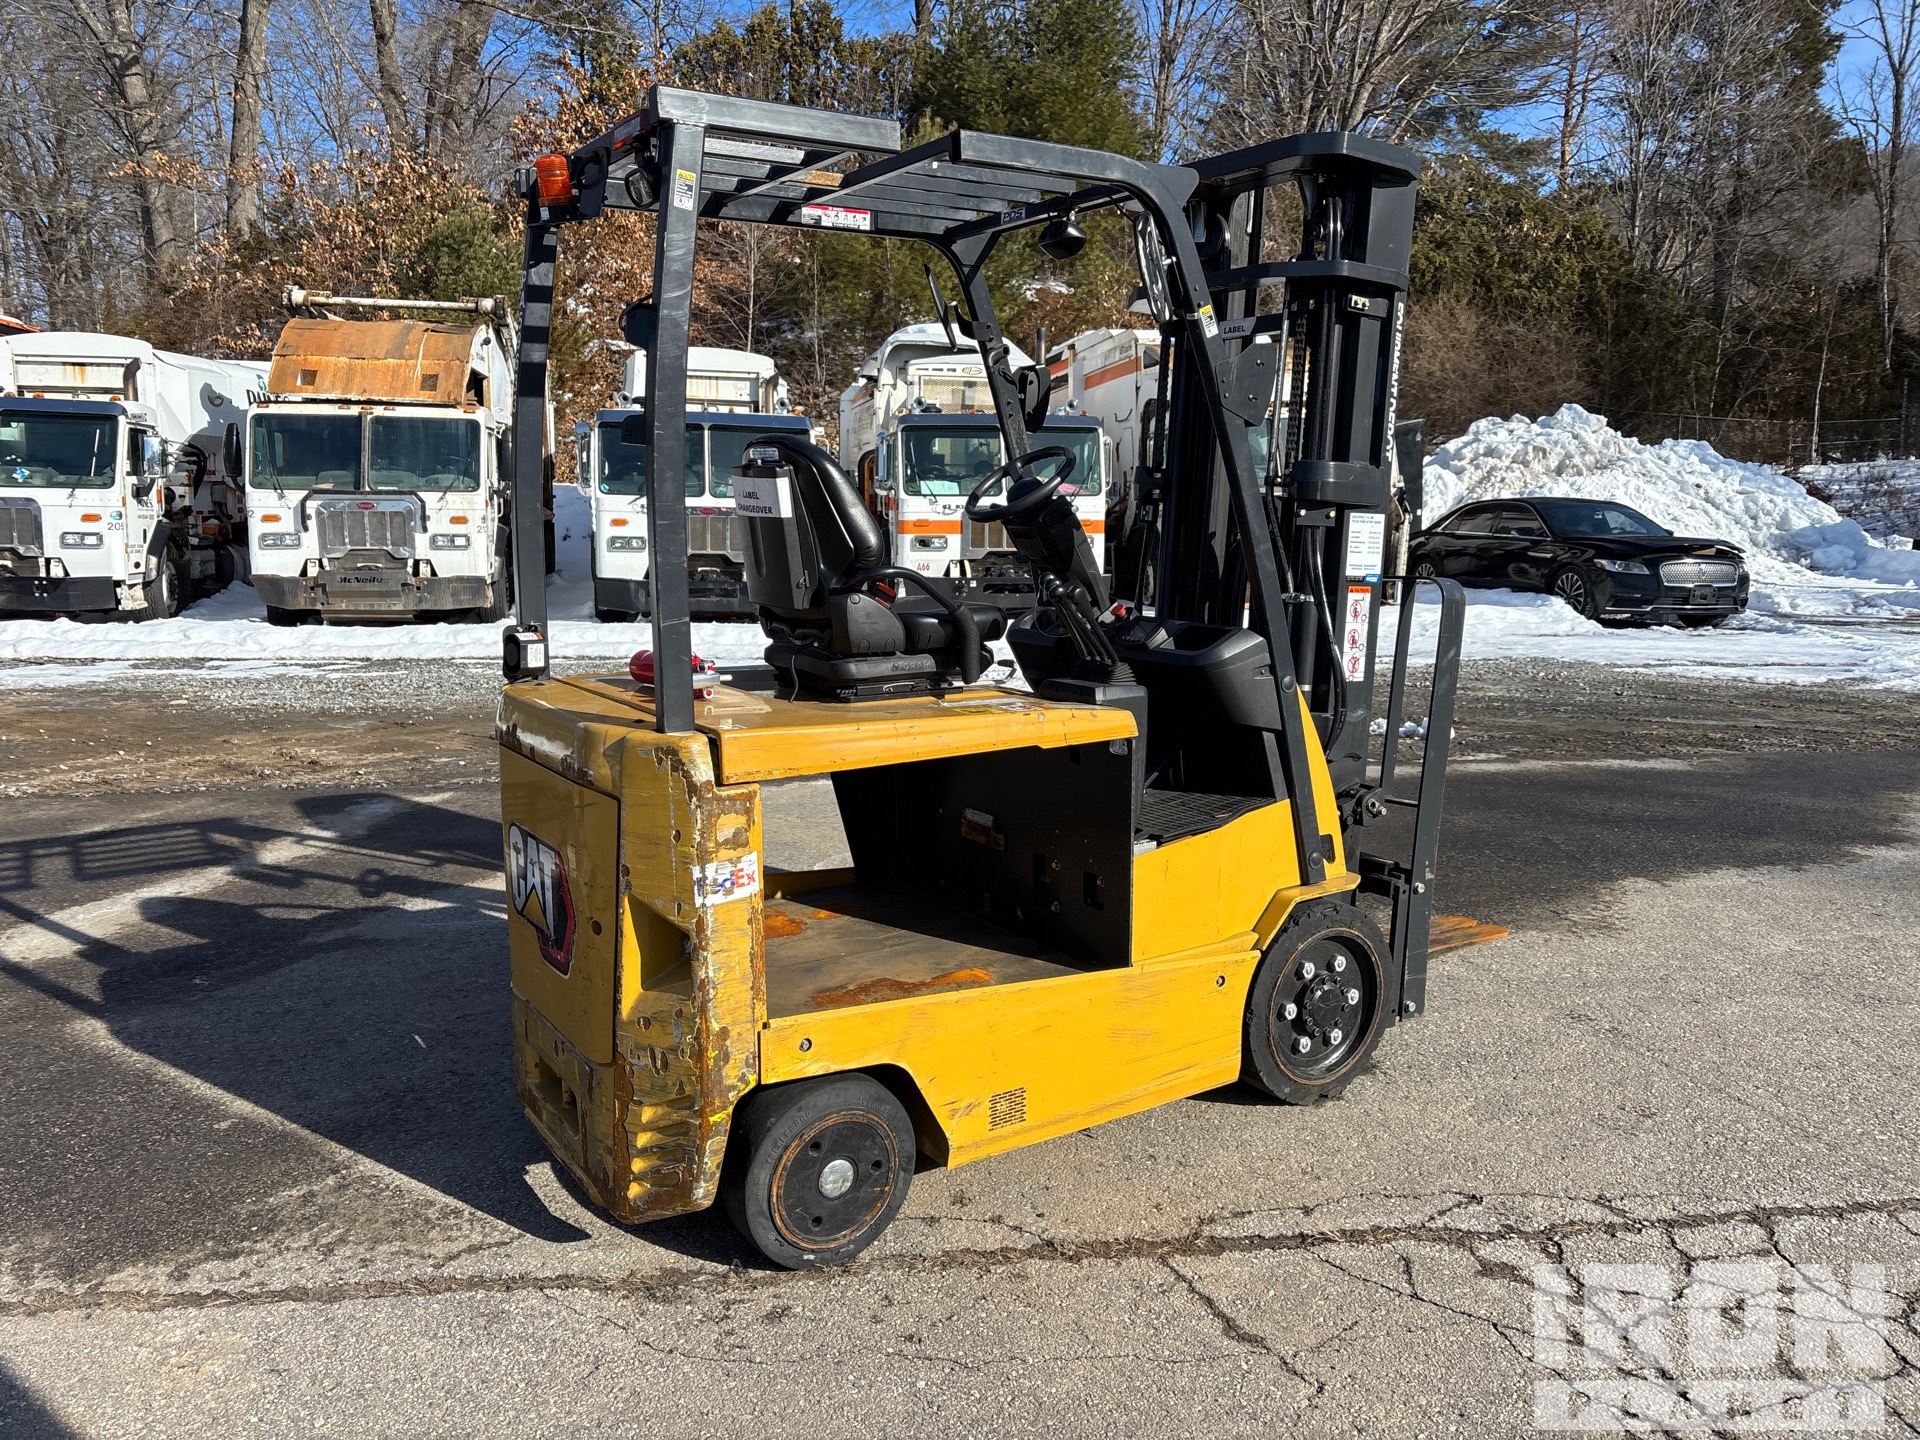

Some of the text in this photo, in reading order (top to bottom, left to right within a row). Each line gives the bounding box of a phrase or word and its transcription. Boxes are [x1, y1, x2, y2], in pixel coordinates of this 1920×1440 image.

[1223, 325, 1245, 335] LABEL
[742, 491, 760, 500] LABEL
[738, 503, 773, 515] CHANGEOVER
[917, 562, 931, 572] A66
[509, 825, 556, 939] CAT
